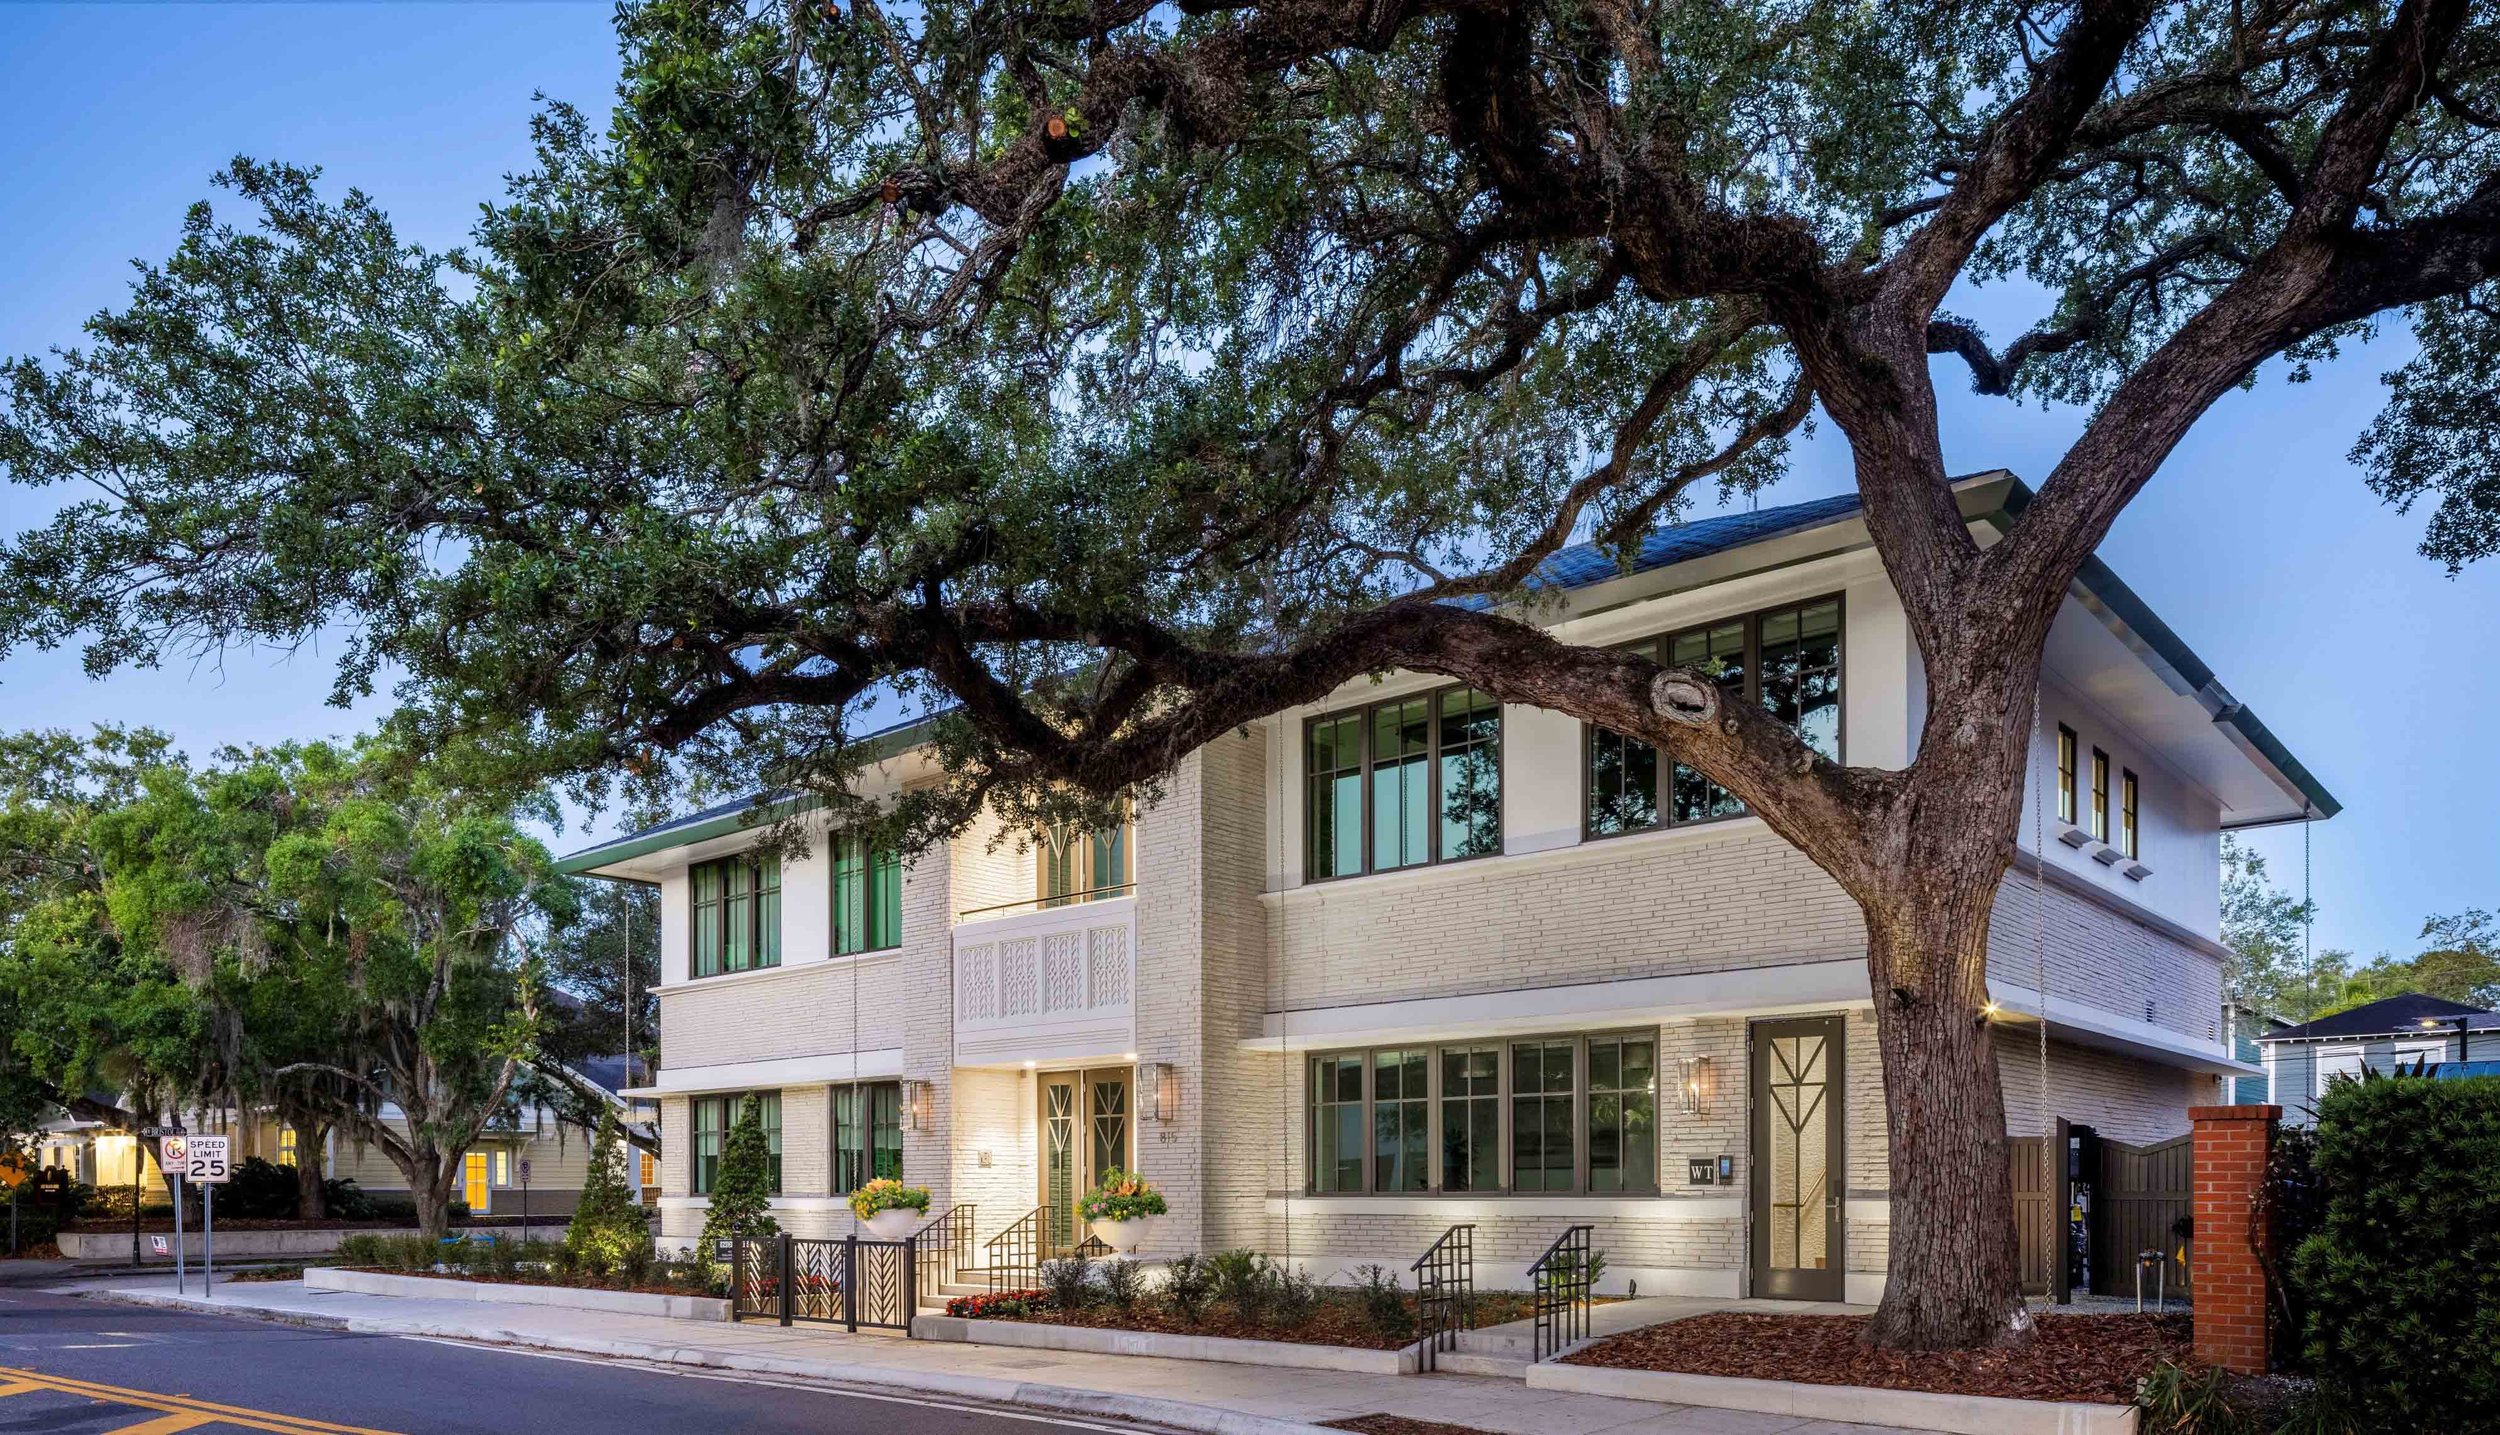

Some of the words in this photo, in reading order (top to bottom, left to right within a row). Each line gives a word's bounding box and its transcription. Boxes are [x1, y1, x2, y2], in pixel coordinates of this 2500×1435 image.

[1160, 1131, 1177, 1143] 815
[190, 1160, 225, 1176] 25
[1691, 1165, 1713, 1180] WT
